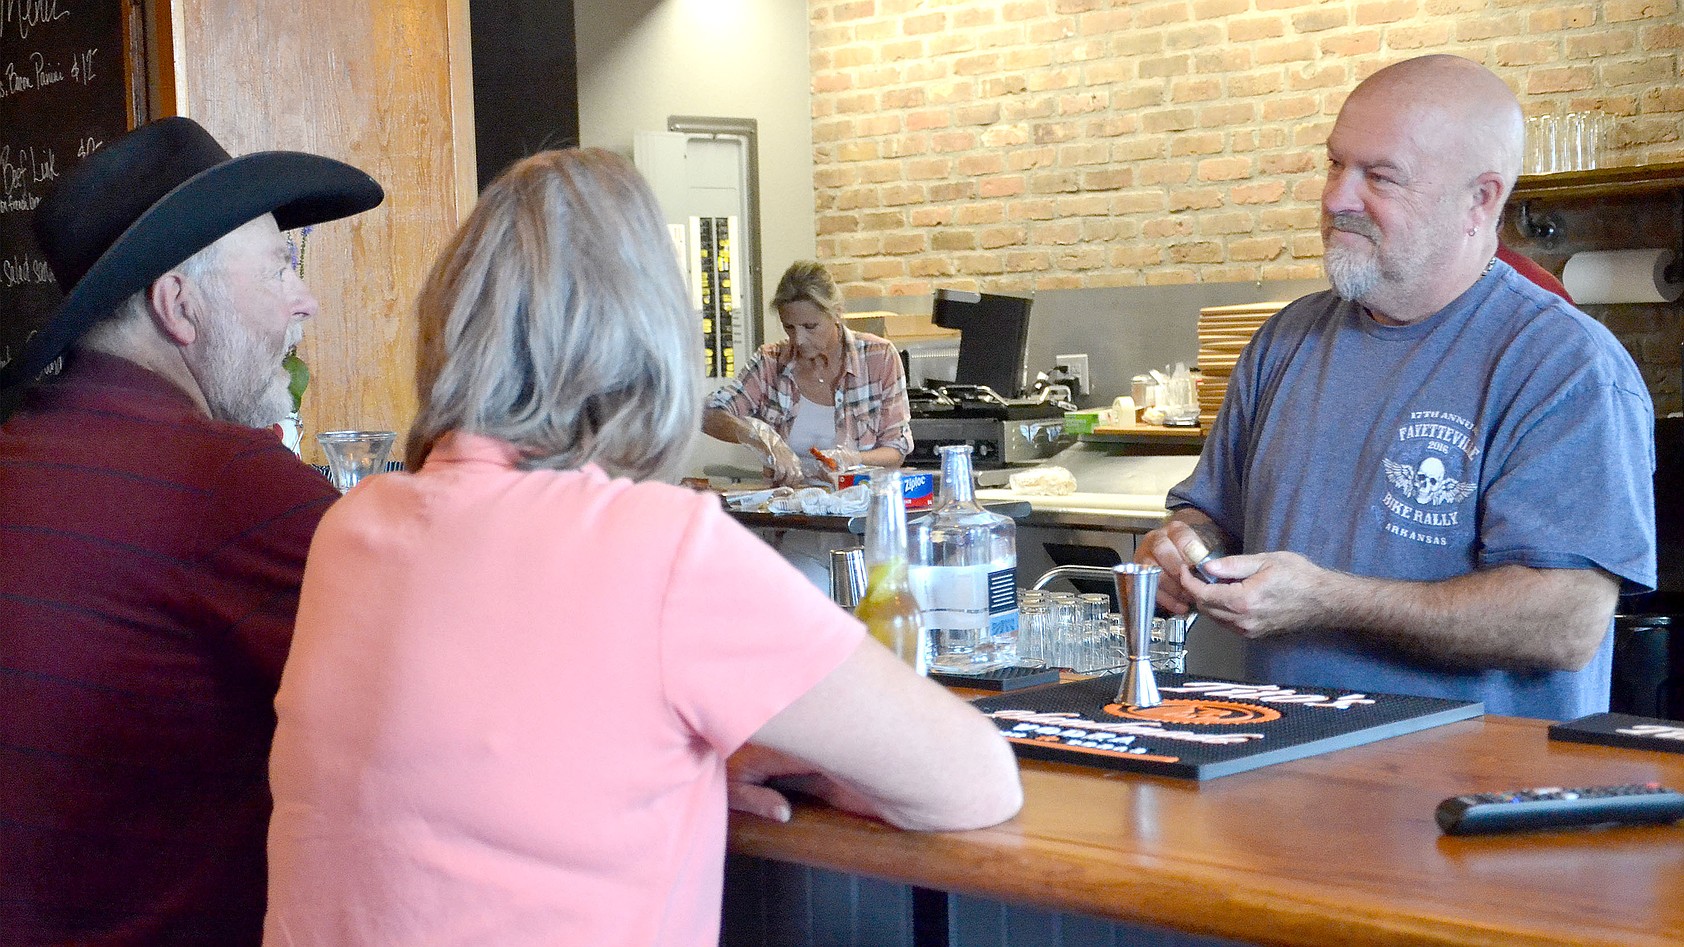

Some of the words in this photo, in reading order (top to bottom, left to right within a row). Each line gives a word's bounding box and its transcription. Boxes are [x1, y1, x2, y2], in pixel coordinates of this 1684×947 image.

[30, 51, 64, 90] Panini
[1411, 410, 1440, 419] 17TH
[1399, 423, 1481, 461] FAYETTEVILLE
[904, 475, 926, 492] Ziploc
[1382, 491, 1414, 520] BIKE
[1413, 509, 1459, 526] RALLY
[1385, 523, 1448, 546] ARKANSAS
